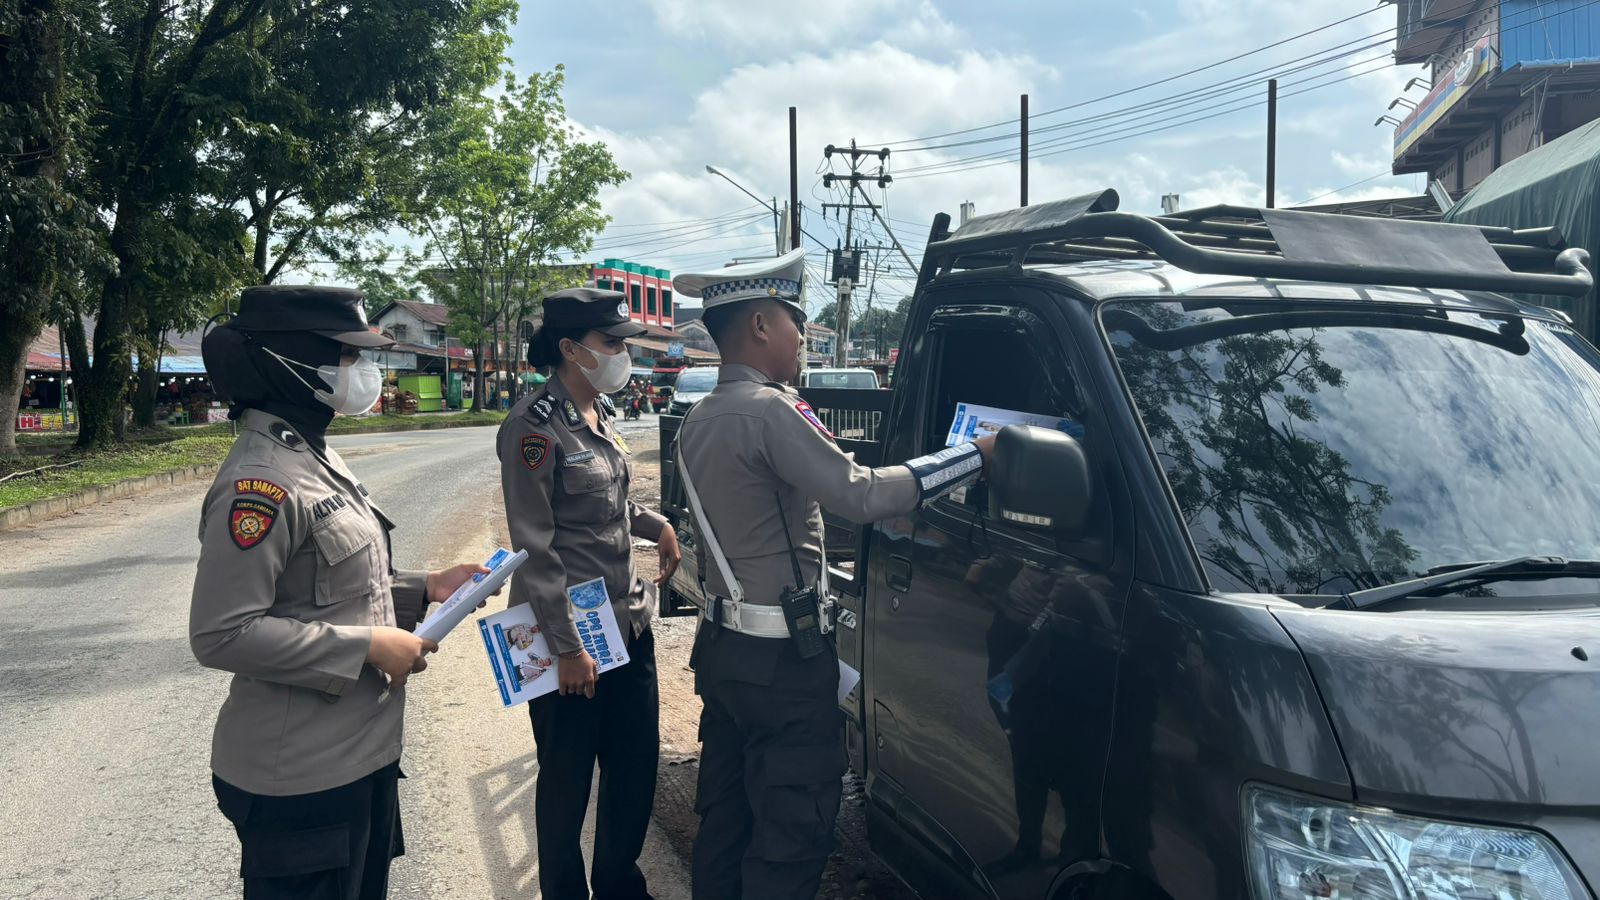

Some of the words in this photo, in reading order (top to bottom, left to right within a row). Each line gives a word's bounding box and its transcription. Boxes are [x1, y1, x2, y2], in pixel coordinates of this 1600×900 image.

[238, 480, 251, 491] SAT
[252, 480, 285, 501] SAMAPTA
[586, 611, 602, 631] OPS
[592, 632, 613, 665] ZEBRA
